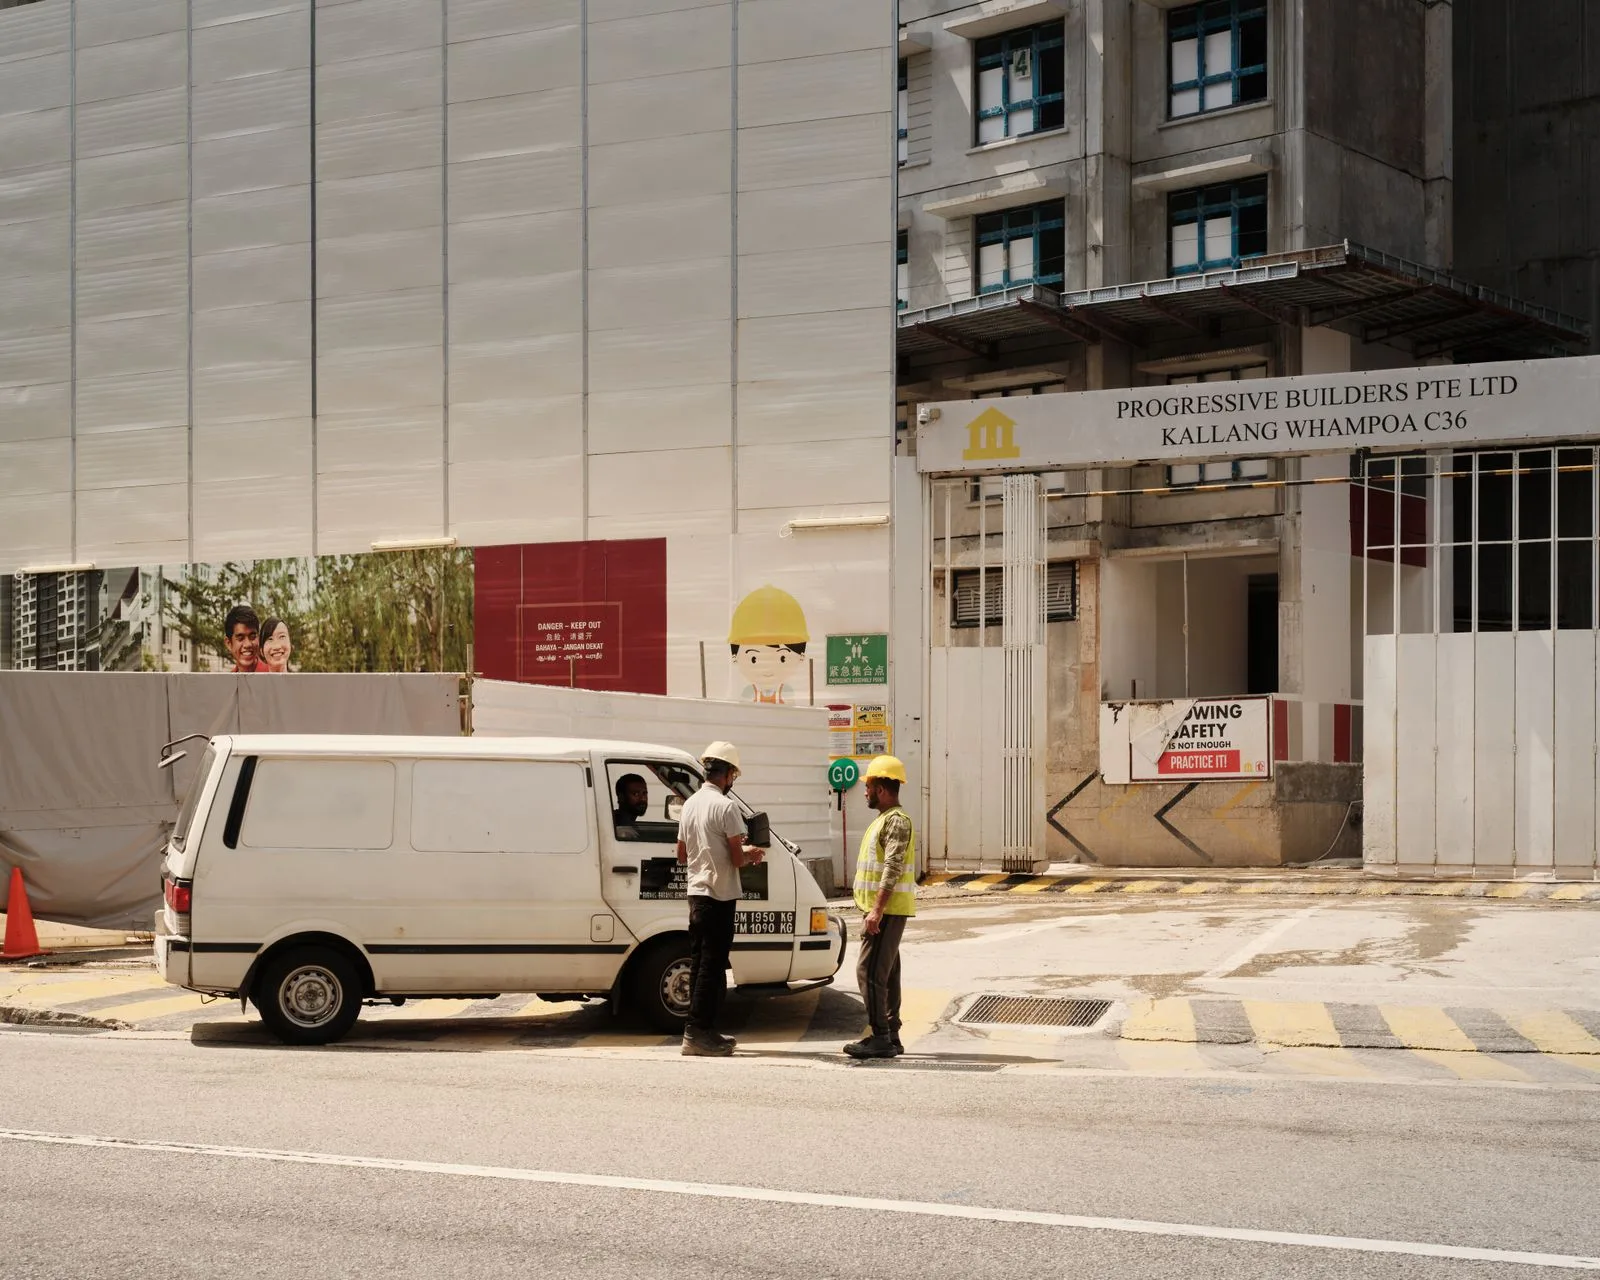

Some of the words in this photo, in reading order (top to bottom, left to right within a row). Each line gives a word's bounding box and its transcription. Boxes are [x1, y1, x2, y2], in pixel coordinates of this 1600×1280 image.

[1015, 51, 1027, 75] 4
[1116, 391, 1278, 419] PROGRESSIVE
[1285, 382, 1408, 409] BUILDERS
[1416, 378, 1462, 400] PTE
[1468, 375, 1518, 397] LTD
[1161, 421, 1278, 446] KALLANG
[1285, 413, 1418, 438] WHAMPOA
[1424, 409, 1467, 431] C36
[537, 622, 563, 630] DANGER
[570, 621, 587, 629] KEEP
[588, 621, 601, 629] OUT
[563, 643, 585, 651] JANGAN
[585, 642, 604, 650] DEKAT
[1196, 741, 1231, 749] ENOUGH
[1170, 755, 1214, 770] PRACTICE
[1215, 754, 1227, 768] IT!
[832, 765, 855, 782] GO
[751, 912, 775, 922] 1950
[780, 912, 793, 922] KG
[750, 923, 775, 933] 1090
[780, 923, 793, 933] KG
